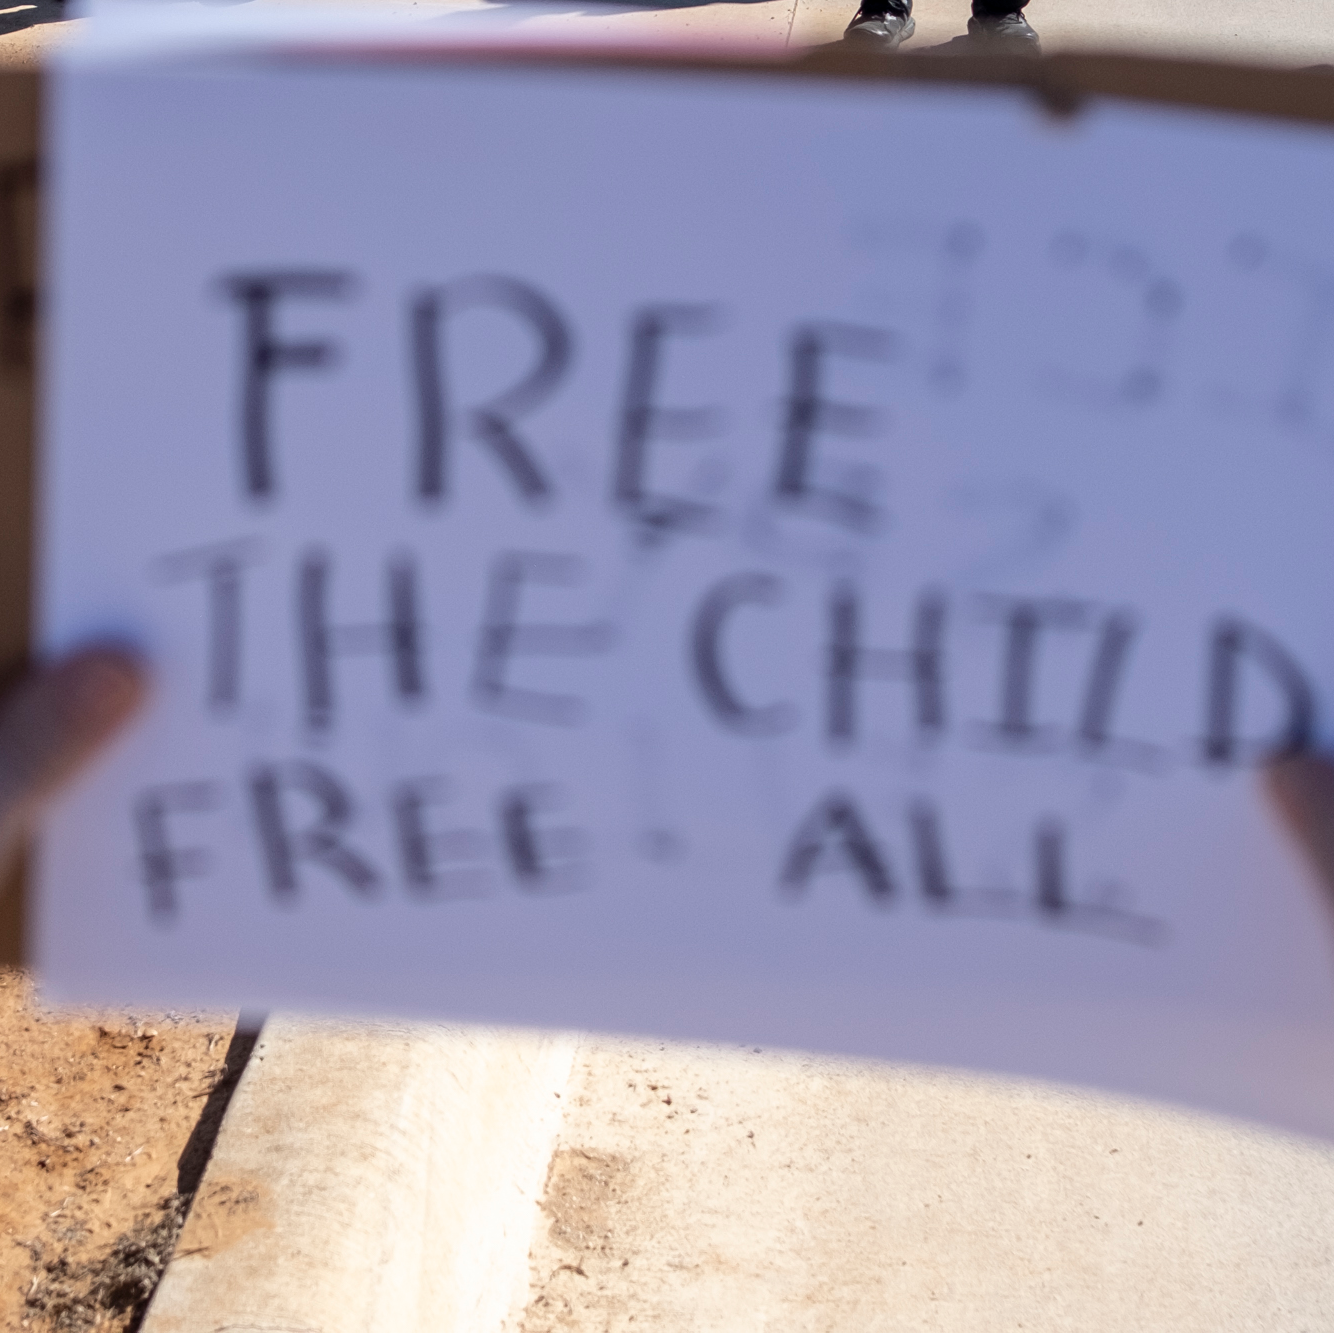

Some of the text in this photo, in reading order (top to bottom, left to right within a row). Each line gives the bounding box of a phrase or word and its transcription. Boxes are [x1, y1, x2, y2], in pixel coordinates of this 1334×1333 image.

[211, 263, 901, 528] FREE
[156, 534, 1323, 772] THE CHILD
[132, 758, 1169, 950] FREE ALL
